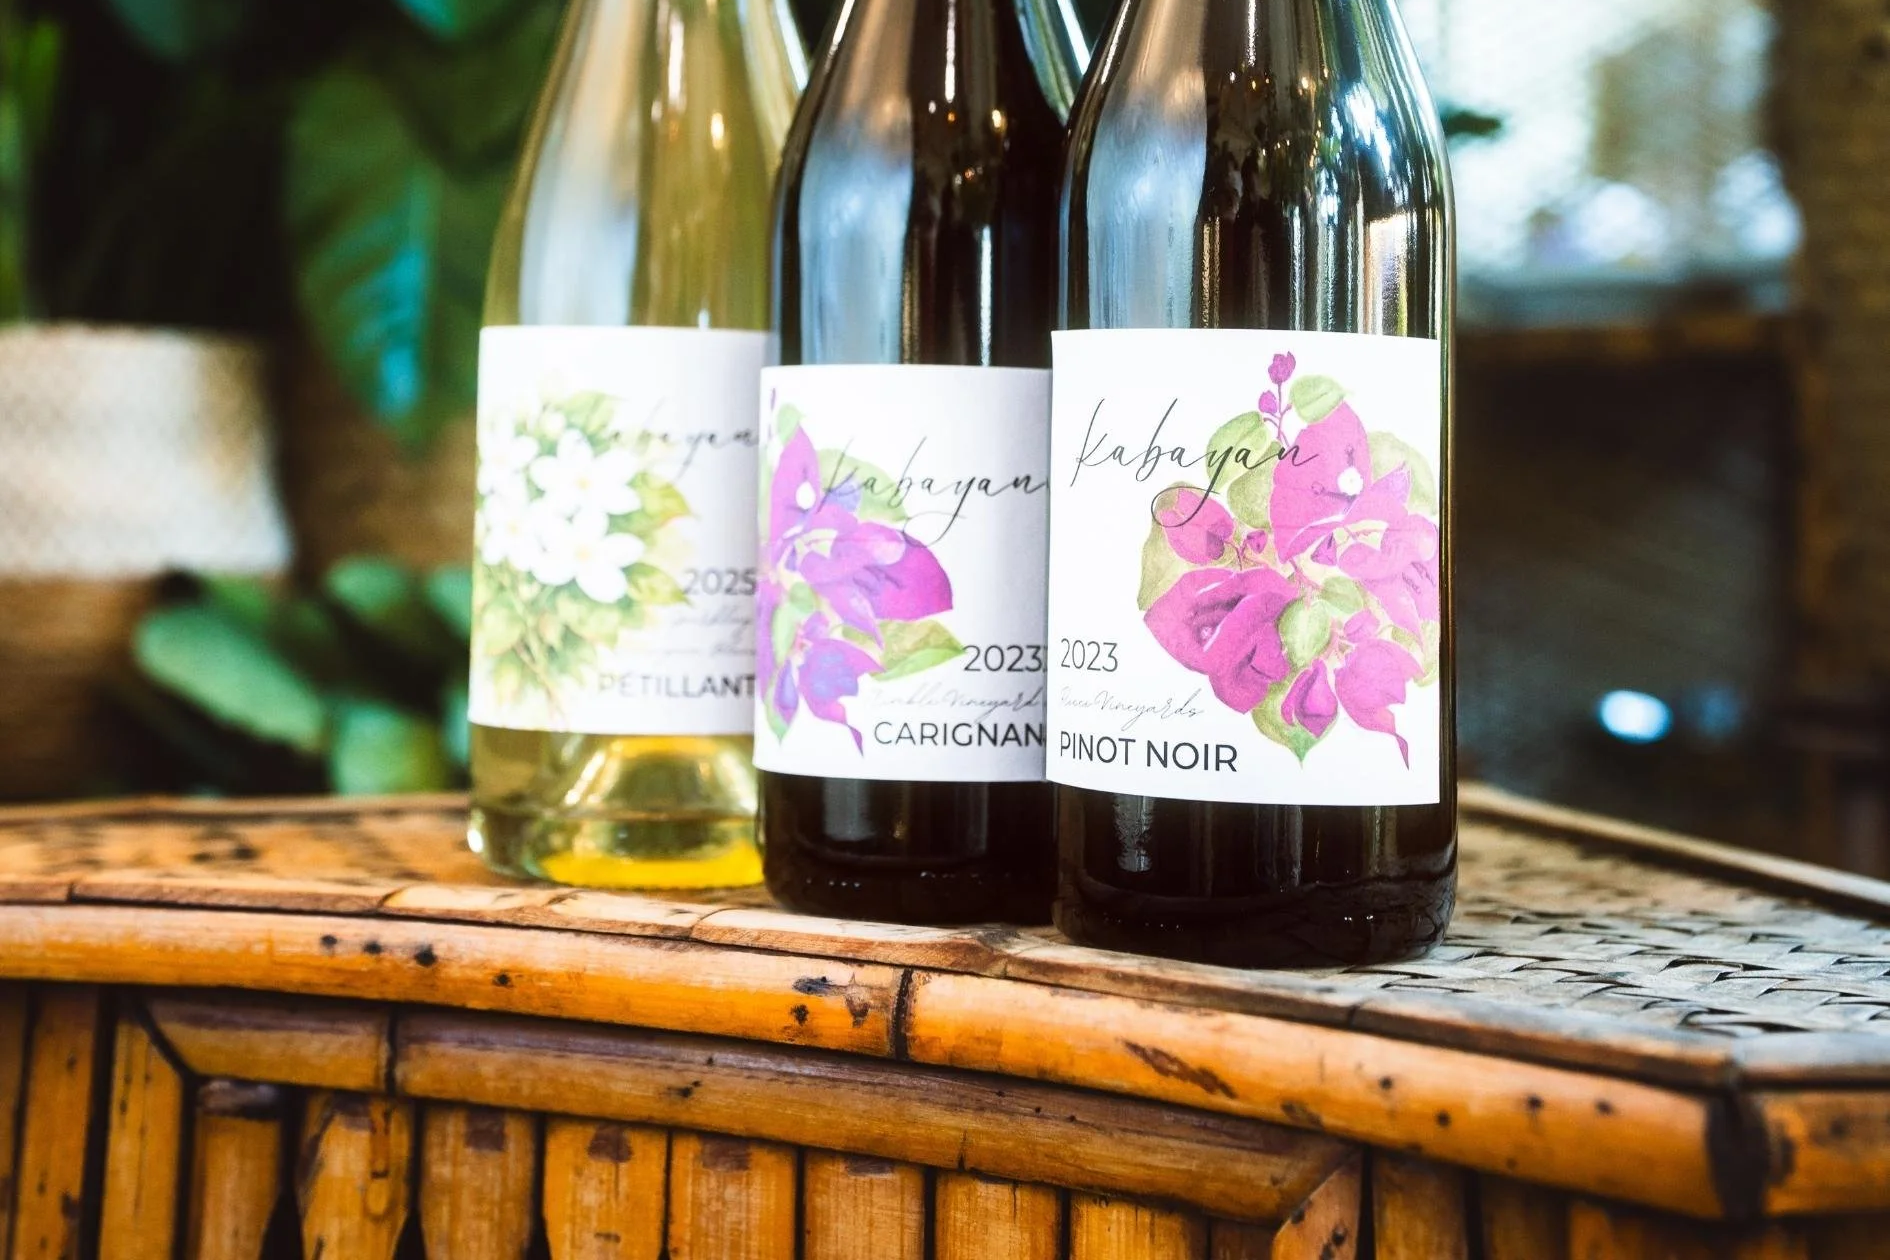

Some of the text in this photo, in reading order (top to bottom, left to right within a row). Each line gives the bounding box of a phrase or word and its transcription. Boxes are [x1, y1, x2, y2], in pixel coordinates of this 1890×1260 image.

[1071, 398, 1319, 527] kabayan
[815, 436, 1048, 548] kabayan
[962, 645, 1043, 672] 2023
[1060, 638, 1119, 673] 2023
[1094, 688, 1205, 732] Vineyards
[874, 721, 1043, 748] CARIGNAN
[1060, 730, 1238, 772] PINOT NOIR
